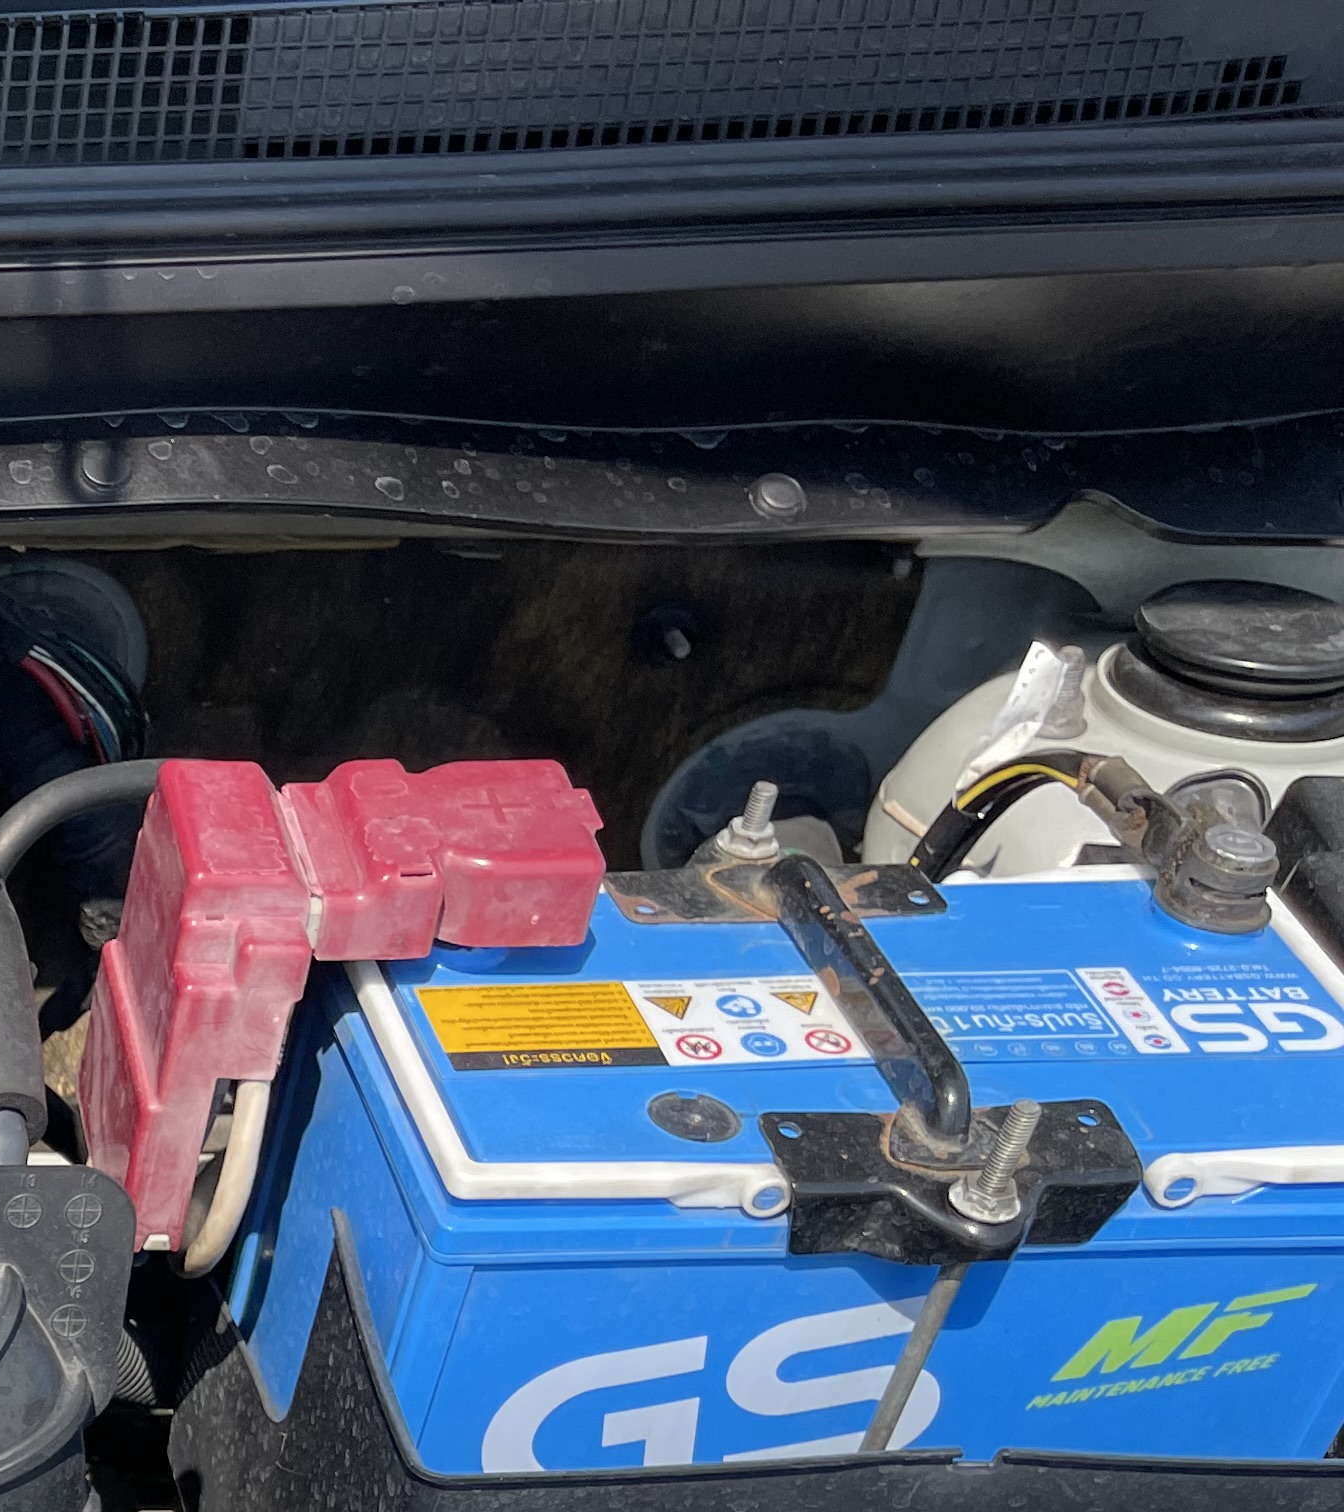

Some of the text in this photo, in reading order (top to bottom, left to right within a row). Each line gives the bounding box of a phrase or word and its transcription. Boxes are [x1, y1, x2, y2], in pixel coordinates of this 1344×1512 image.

[1163, 986, 1310, 1001] BATTERY
[953, 1015, 970, 1031] 1
[971, 1011, 1104, 1032] รับประกัน
[1169, 1002, 1344, 1053] GS
[1051, 1283, 1318, 1382] MF
[481, 1296, 941, 1473] GS
[1025, 1353, 1281, 1411] MAINTENANCE FREE
